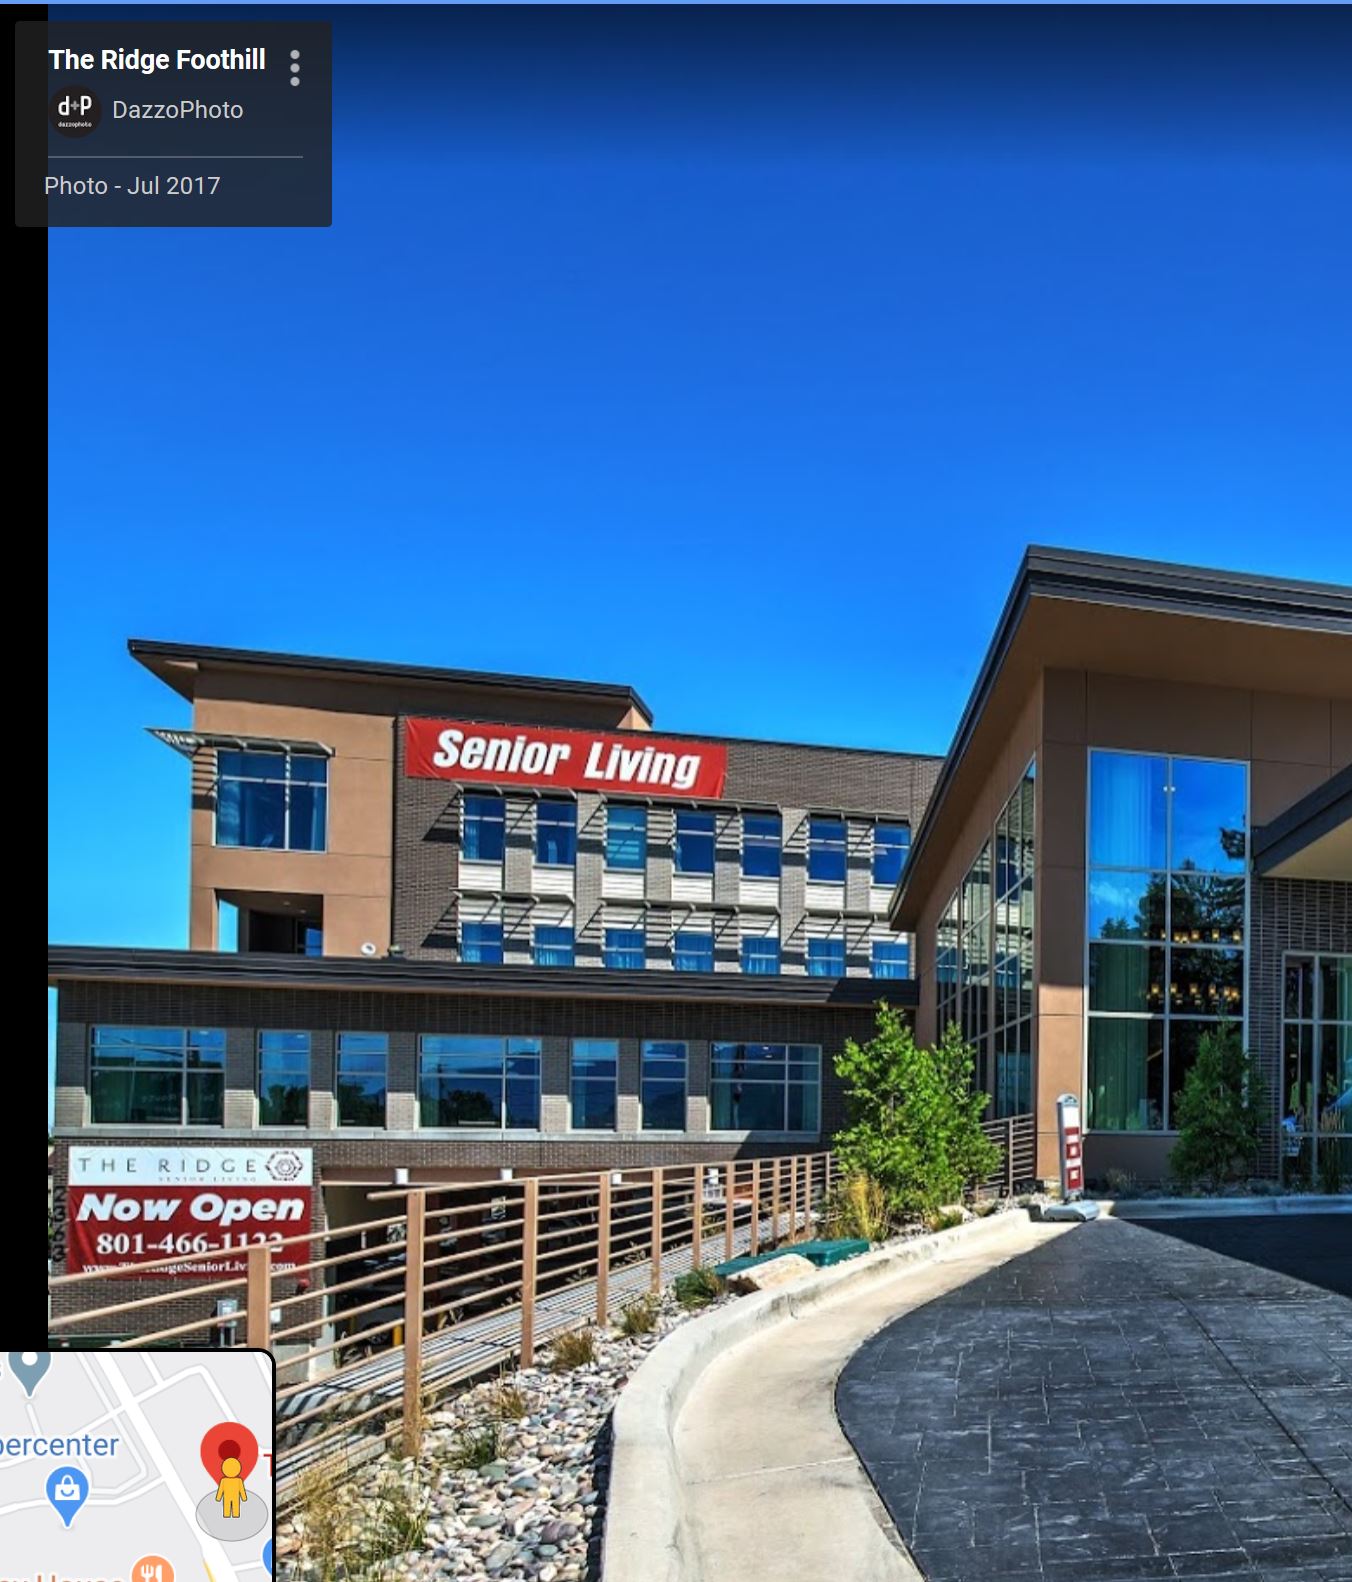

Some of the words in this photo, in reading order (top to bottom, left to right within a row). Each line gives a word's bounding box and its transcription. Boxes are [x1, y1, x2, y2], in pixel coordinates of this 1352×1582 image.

[433, 729, 571, 775] Senior
[584, 741, 701, 790] Living
[78, 1158, 137, 1173] THE
[158, 1158, 256, 1173] RIDGE
[76, 1193, 182, 1221] Now
[190, 1193, 304, 1227] Open
